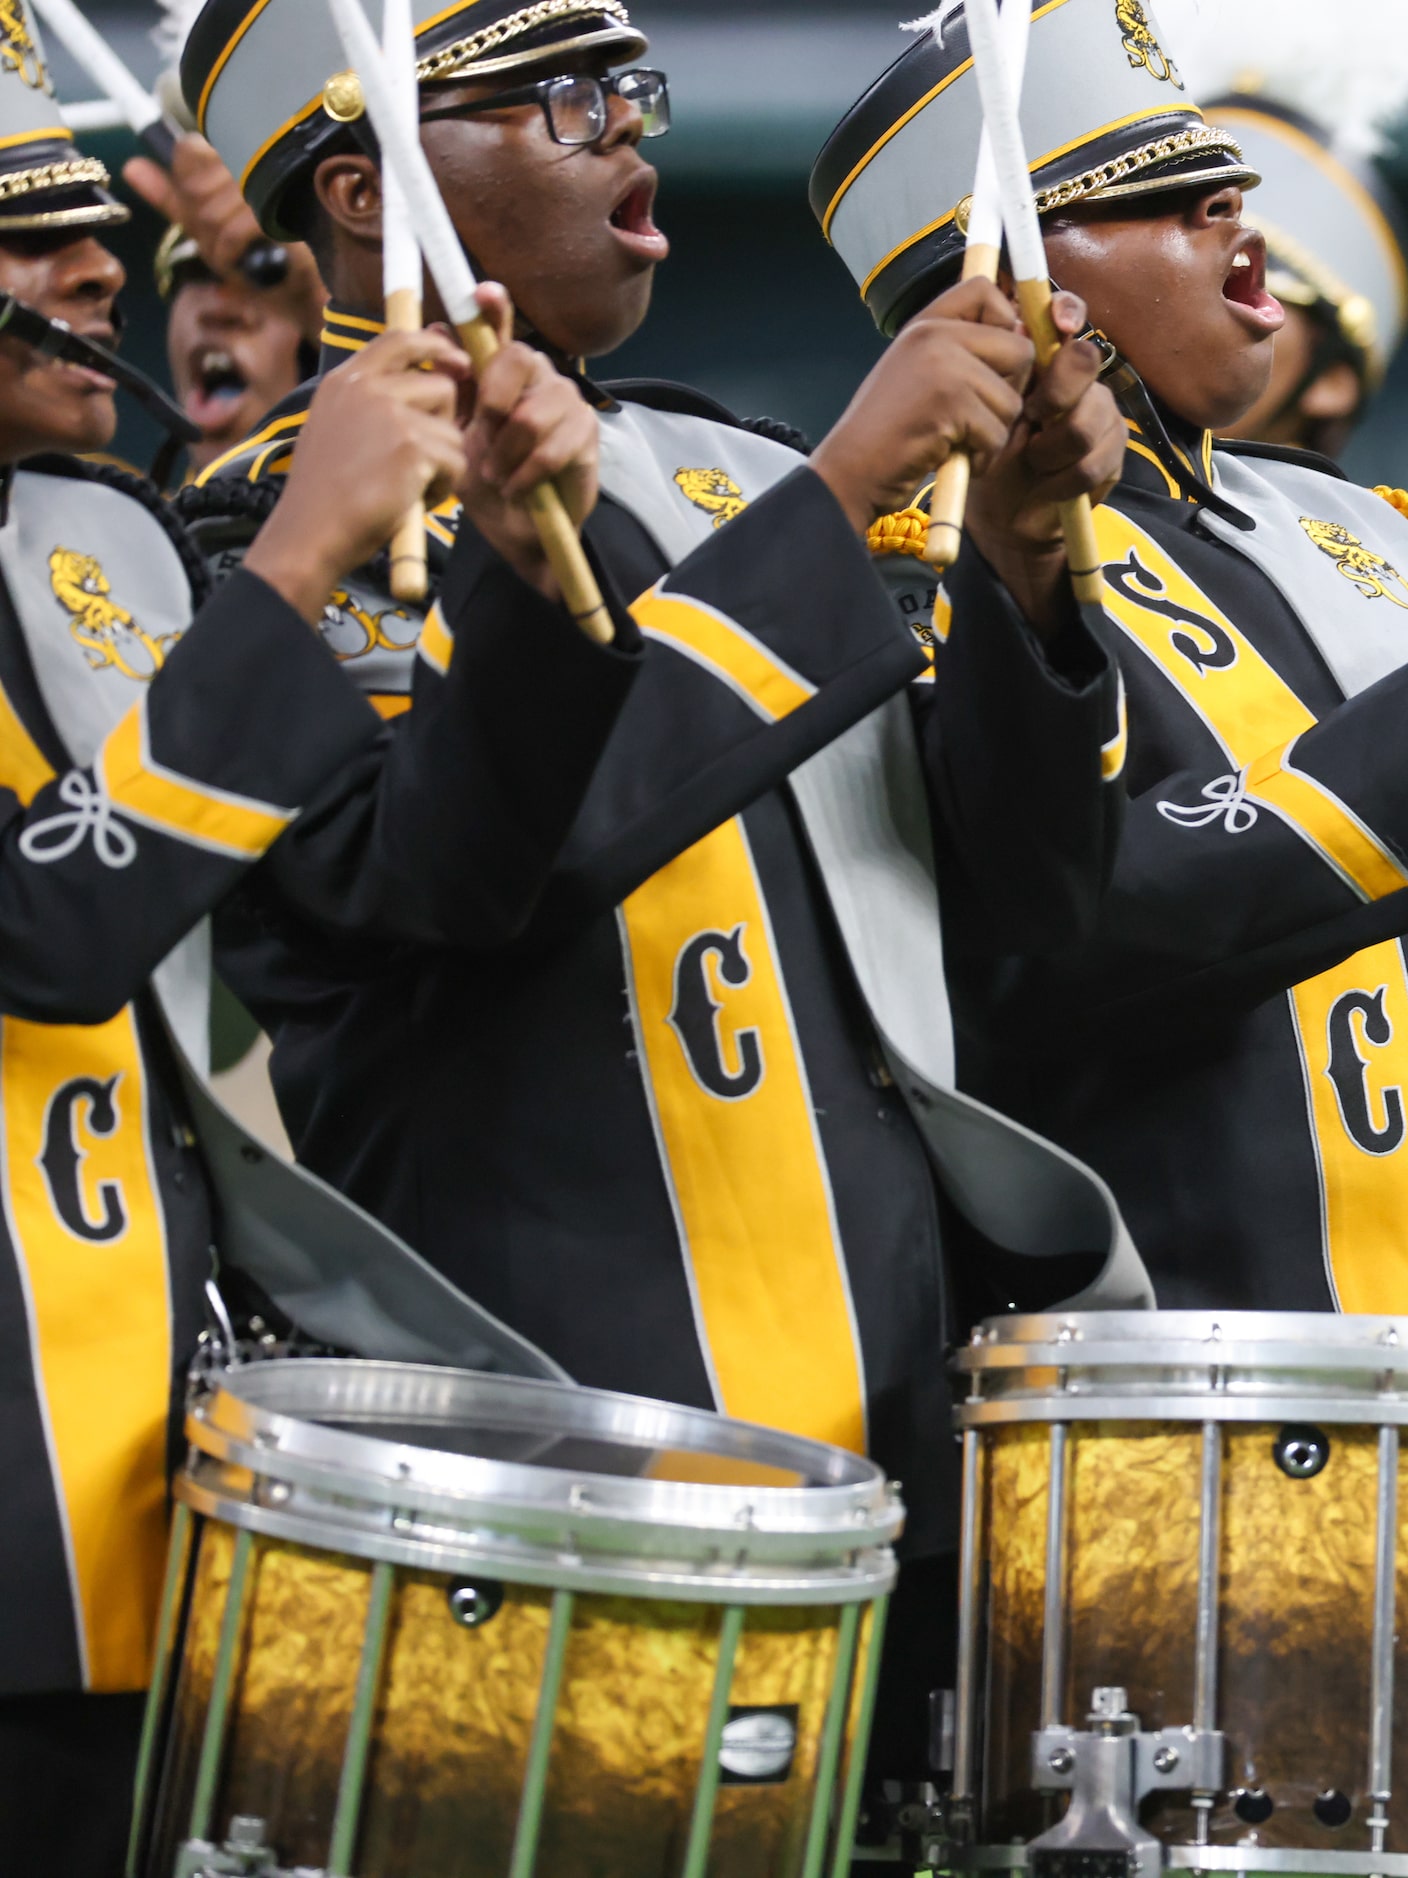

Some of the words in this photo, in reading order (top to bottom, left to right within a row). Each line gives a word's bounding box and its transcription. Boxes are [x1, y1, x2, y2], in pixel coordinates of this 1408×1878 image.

[1103, 547, 1237, 678] S
[664, 922, 765, 1102] C
[1323, 984, 1407, 1157] C
[36, 1071, 129, 1244] C
